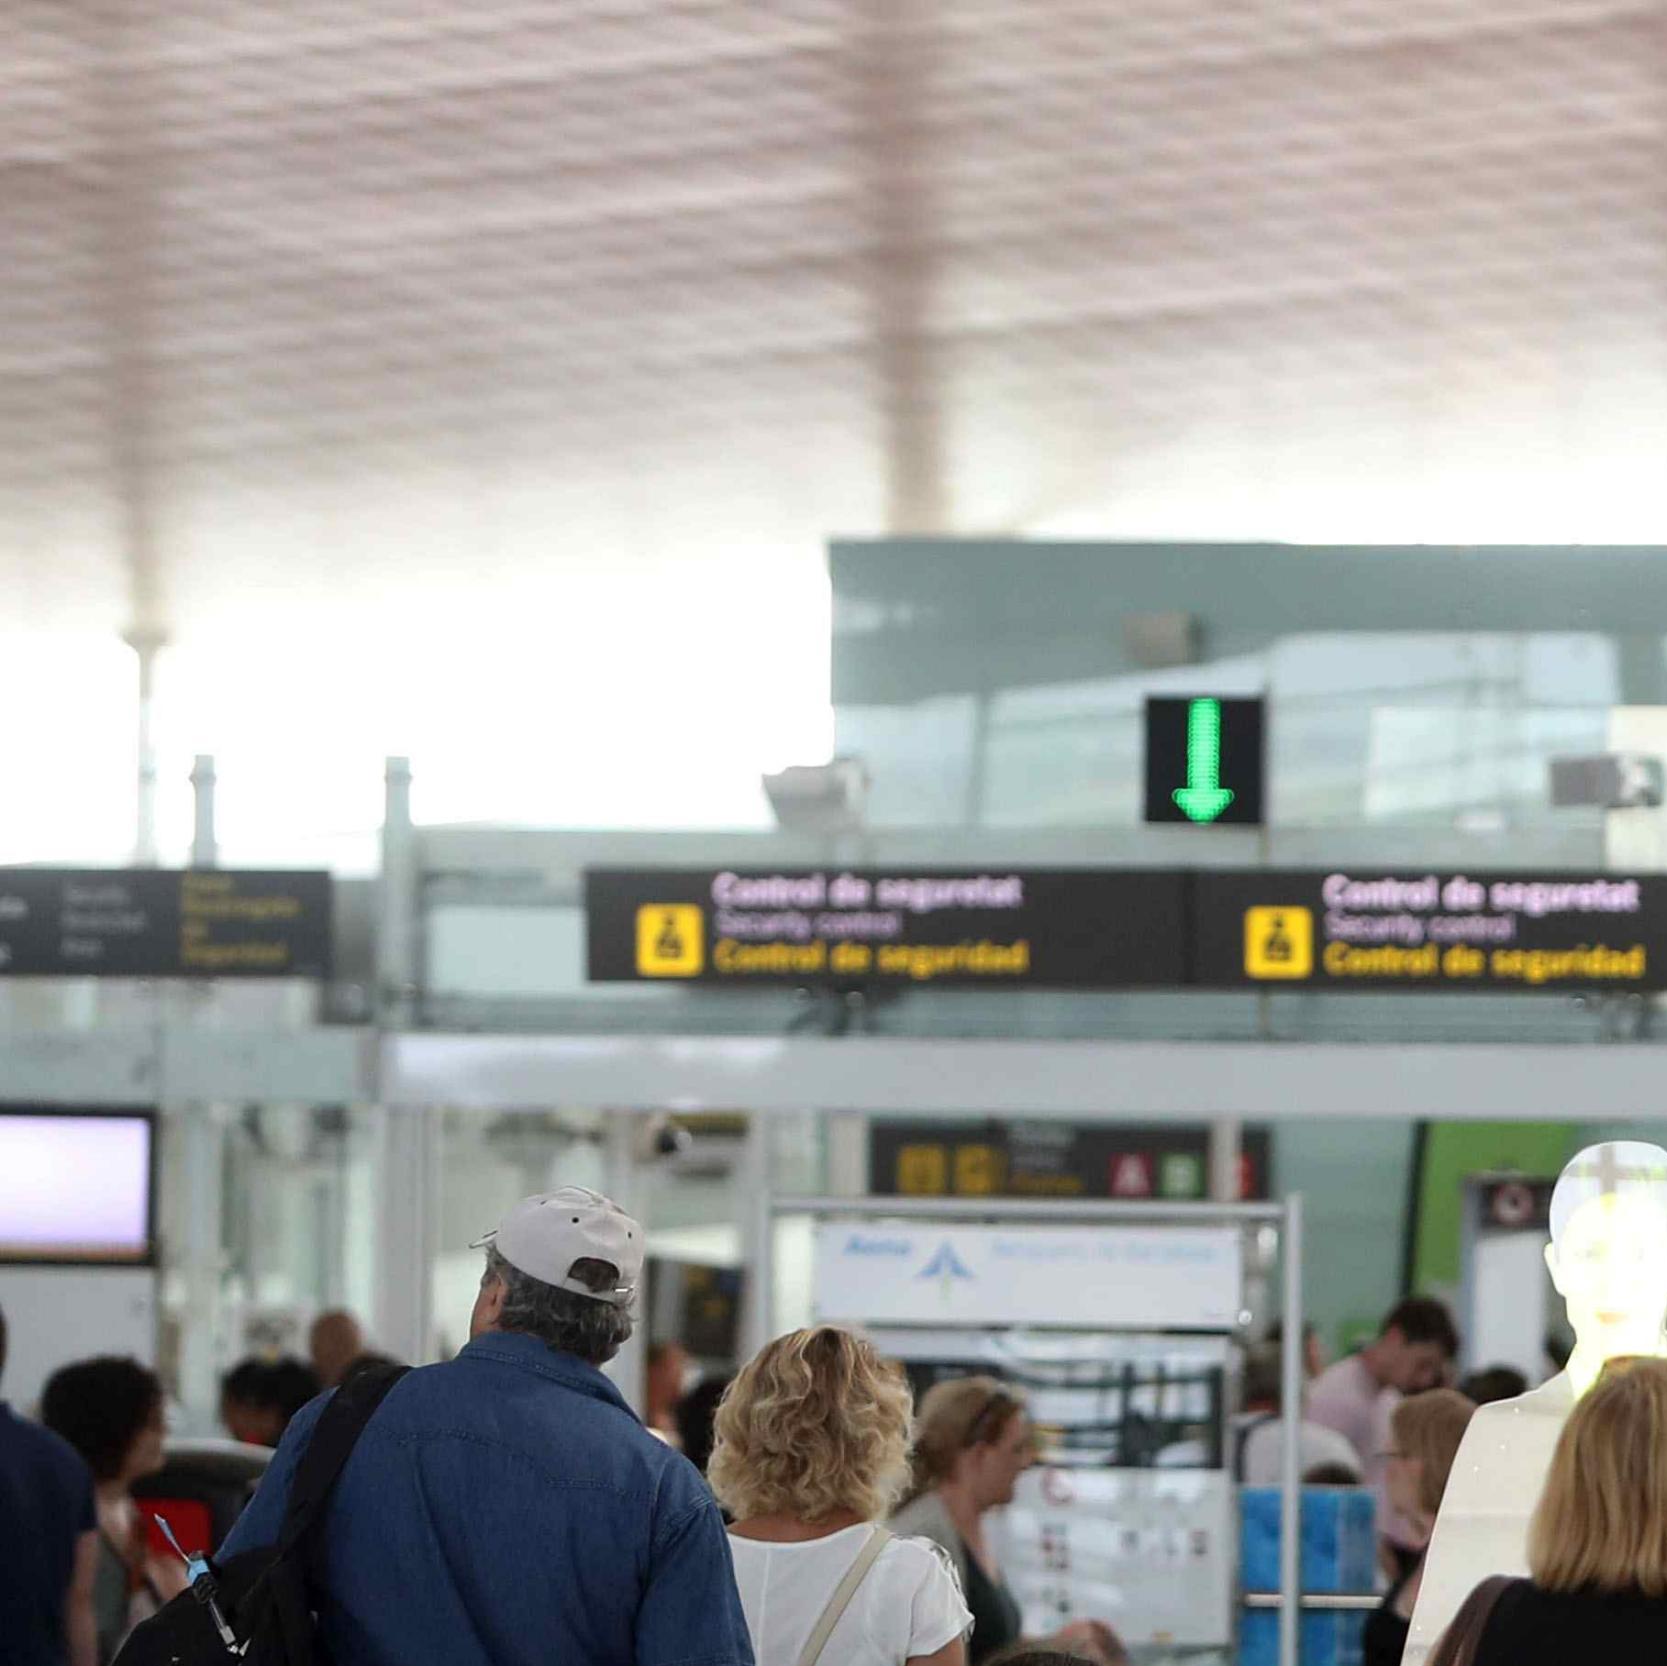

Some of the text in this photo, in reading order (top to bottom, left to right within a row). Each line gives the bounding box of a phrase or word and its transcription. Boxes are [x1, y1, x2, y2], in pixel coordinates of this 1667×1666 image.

[712, 873, 1023, 914] Control de seguretat
[1322, 875, 1641, 916] Control de seguretat
[713, 939, 1030, 980] Control de seguridad
[1323, 942, 1646, 984] Control de seguridad
